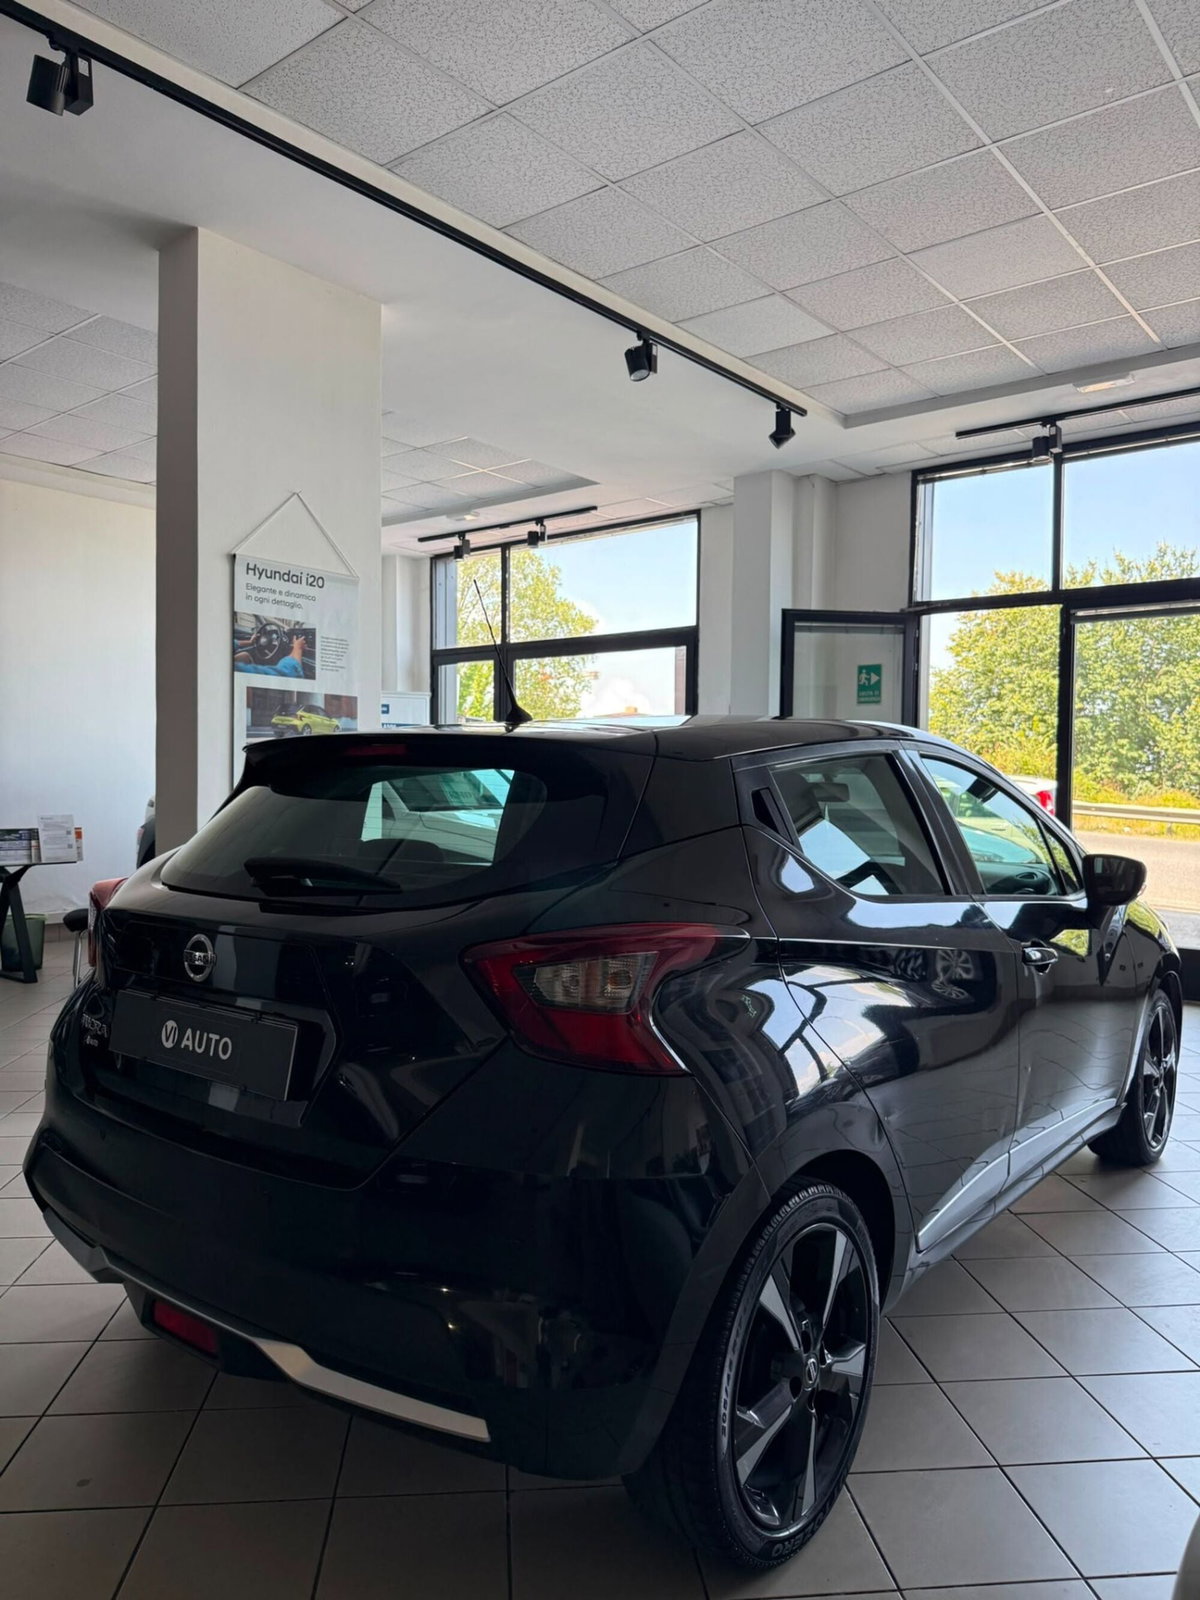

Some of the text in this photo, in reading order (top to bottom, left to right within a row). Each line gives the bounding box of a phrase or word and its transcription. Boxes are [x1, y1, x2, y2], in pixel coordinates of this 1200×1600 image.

[246, 562, 325, 589] Hyundai i20
[246, 582, 277, 595] Elegante
[246, 592, 253, 600] in
[254, 595, 270, 604] ogni
[181, 1027, 232, 1060] AUTO
